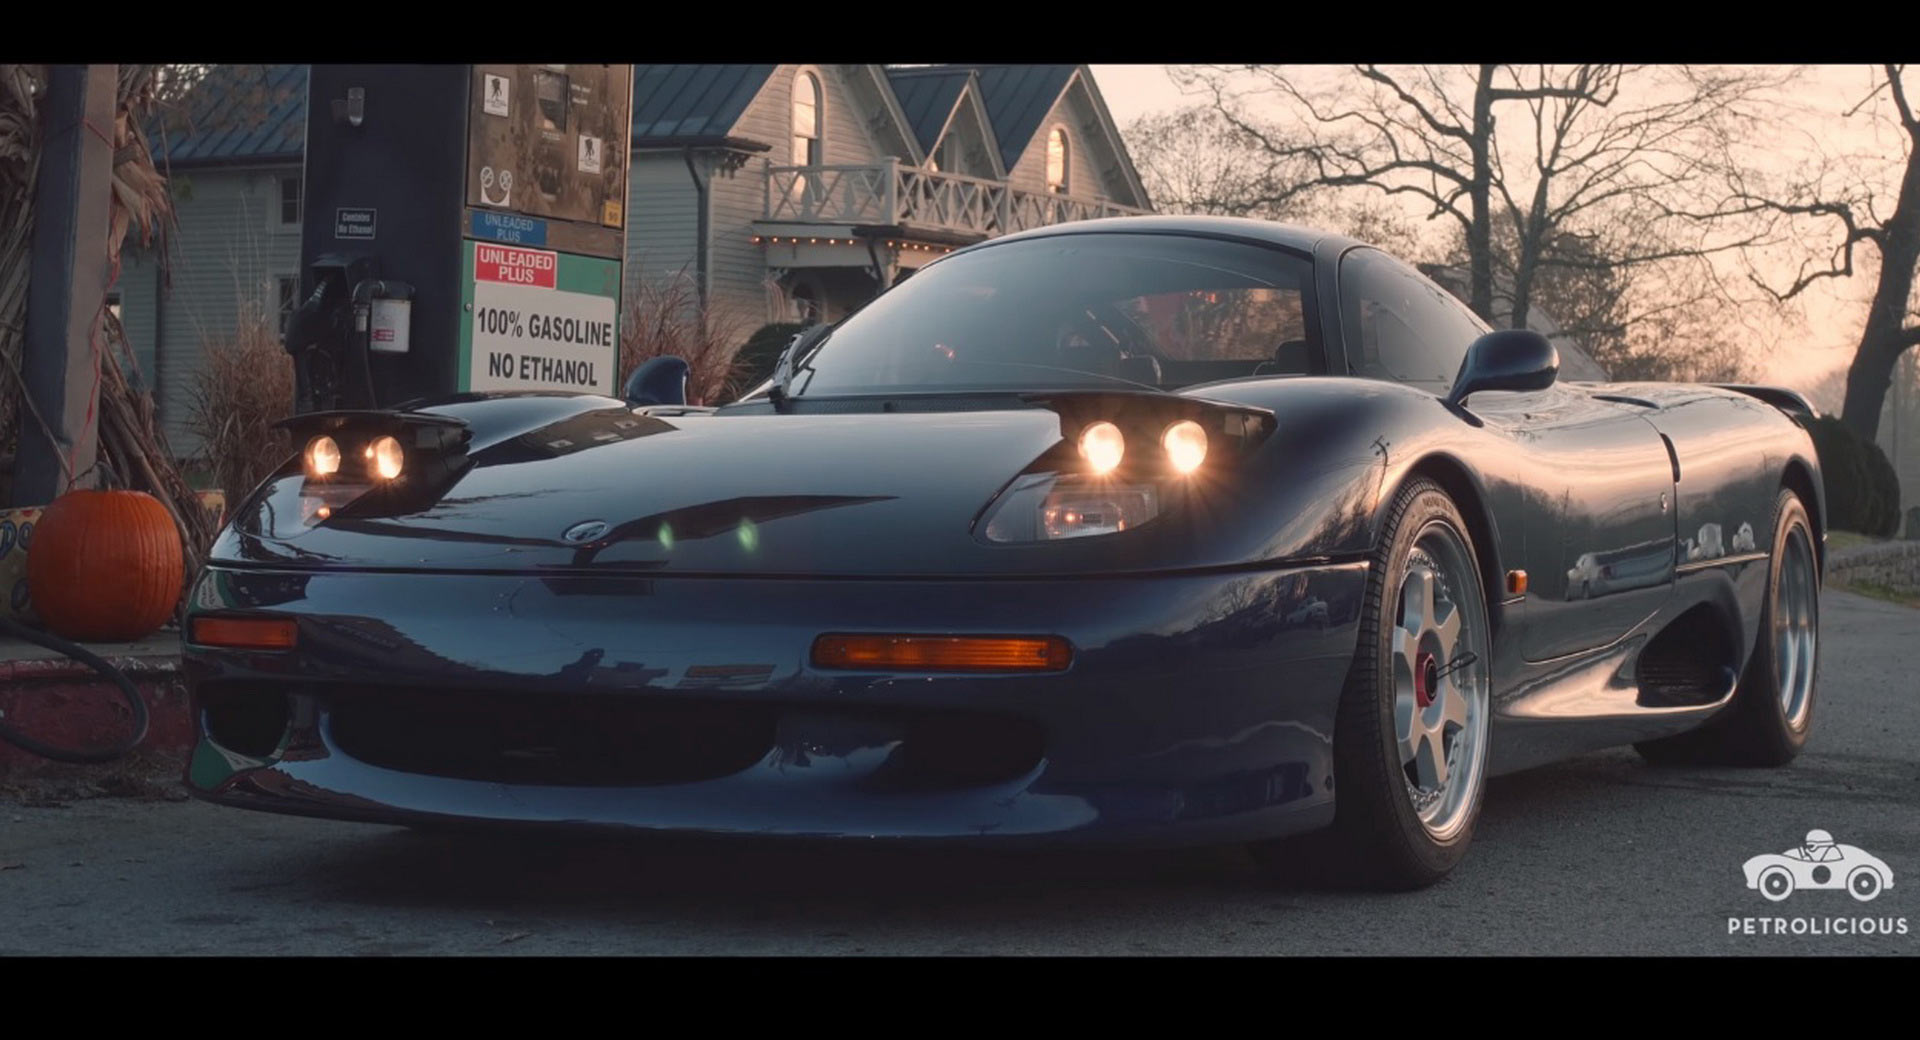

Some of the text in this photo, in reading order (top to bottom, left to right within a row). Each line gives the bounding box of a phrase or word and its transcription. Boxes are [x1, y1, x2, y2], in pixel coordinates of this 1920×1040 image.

[485, 213, 534, 232] UNLEADED
[497, 228, 521, 242] PLUS
[480, 248, 553, 270] UNLEADED
[498, 265, 535, 284] PLUS
[478, 307, 612, 347] 100% GASOLINE
[489, 352, 598, 387] NO ETHANOL
